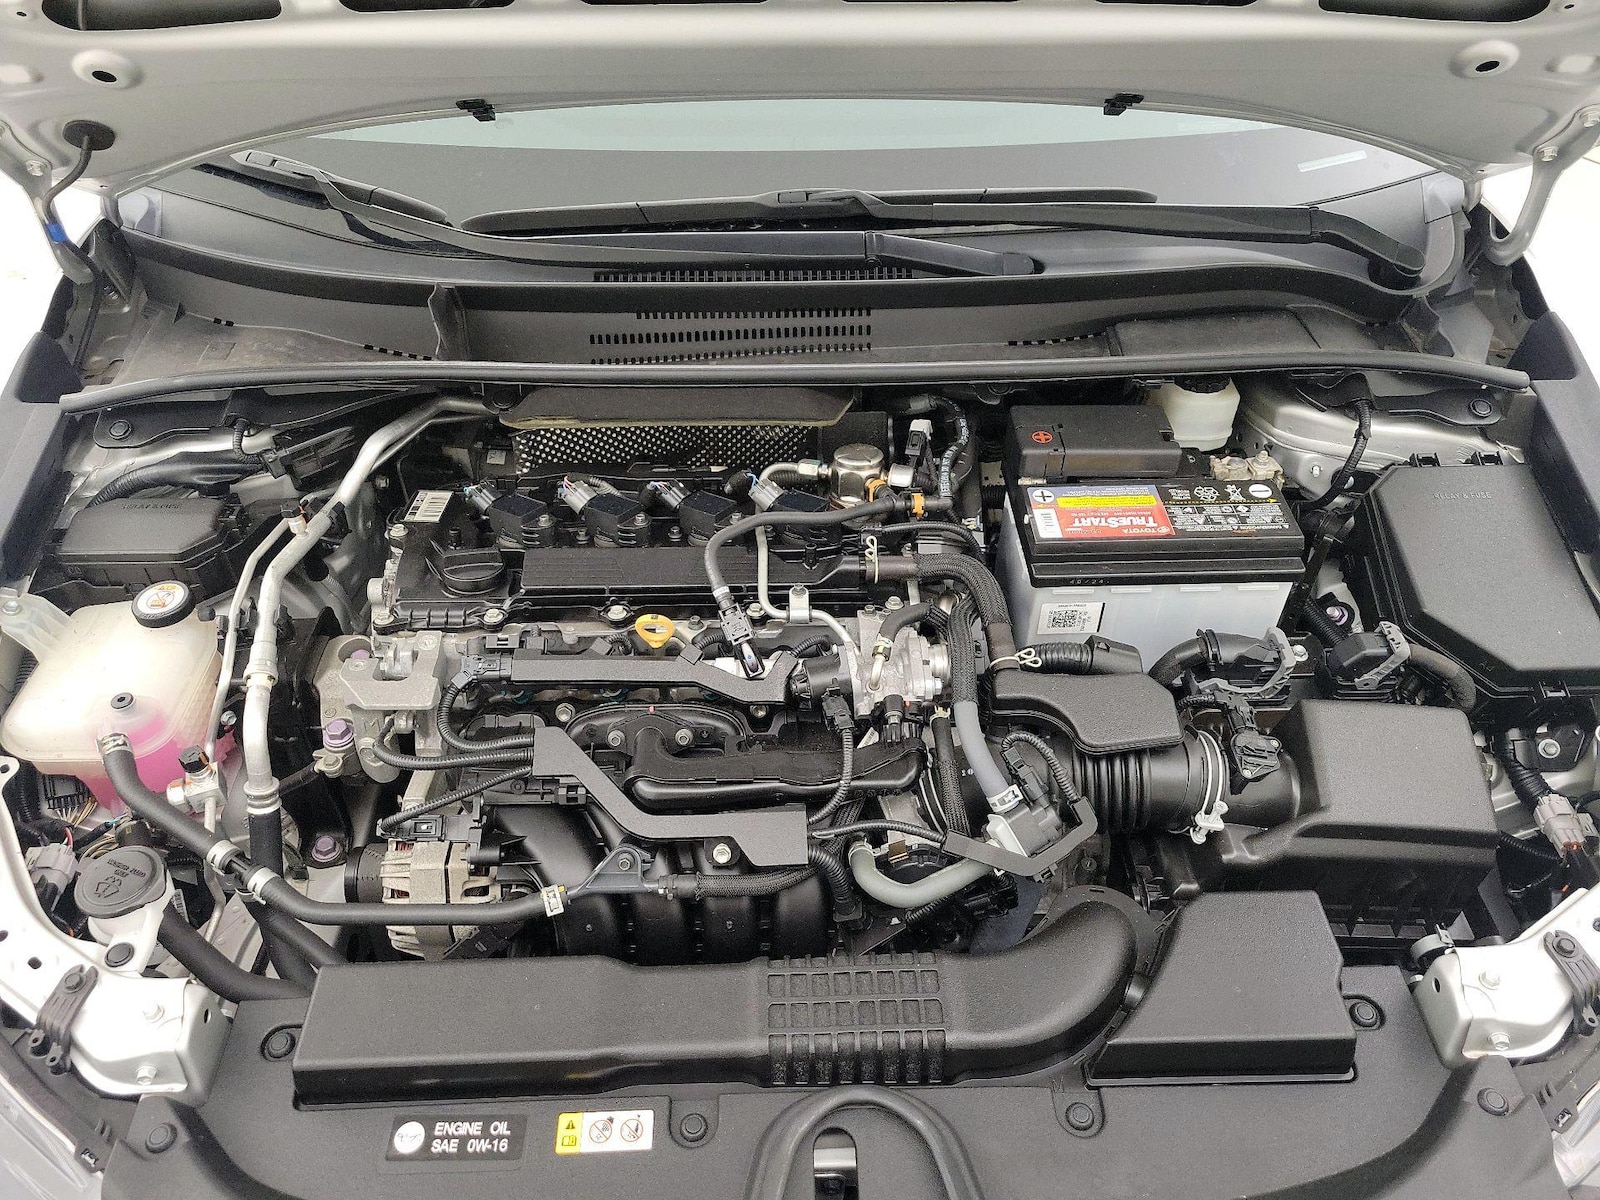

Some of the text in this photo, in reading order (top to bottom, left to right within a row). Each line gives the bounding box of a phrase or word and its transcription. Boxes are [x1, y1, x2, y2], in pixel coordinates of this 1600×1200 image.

[1470, 491, 1491, 500] FUSE
[434, 1121, 511, 1136] ENGINE OIL
[430, 1138, 508, 1153] SAE 0W-16
